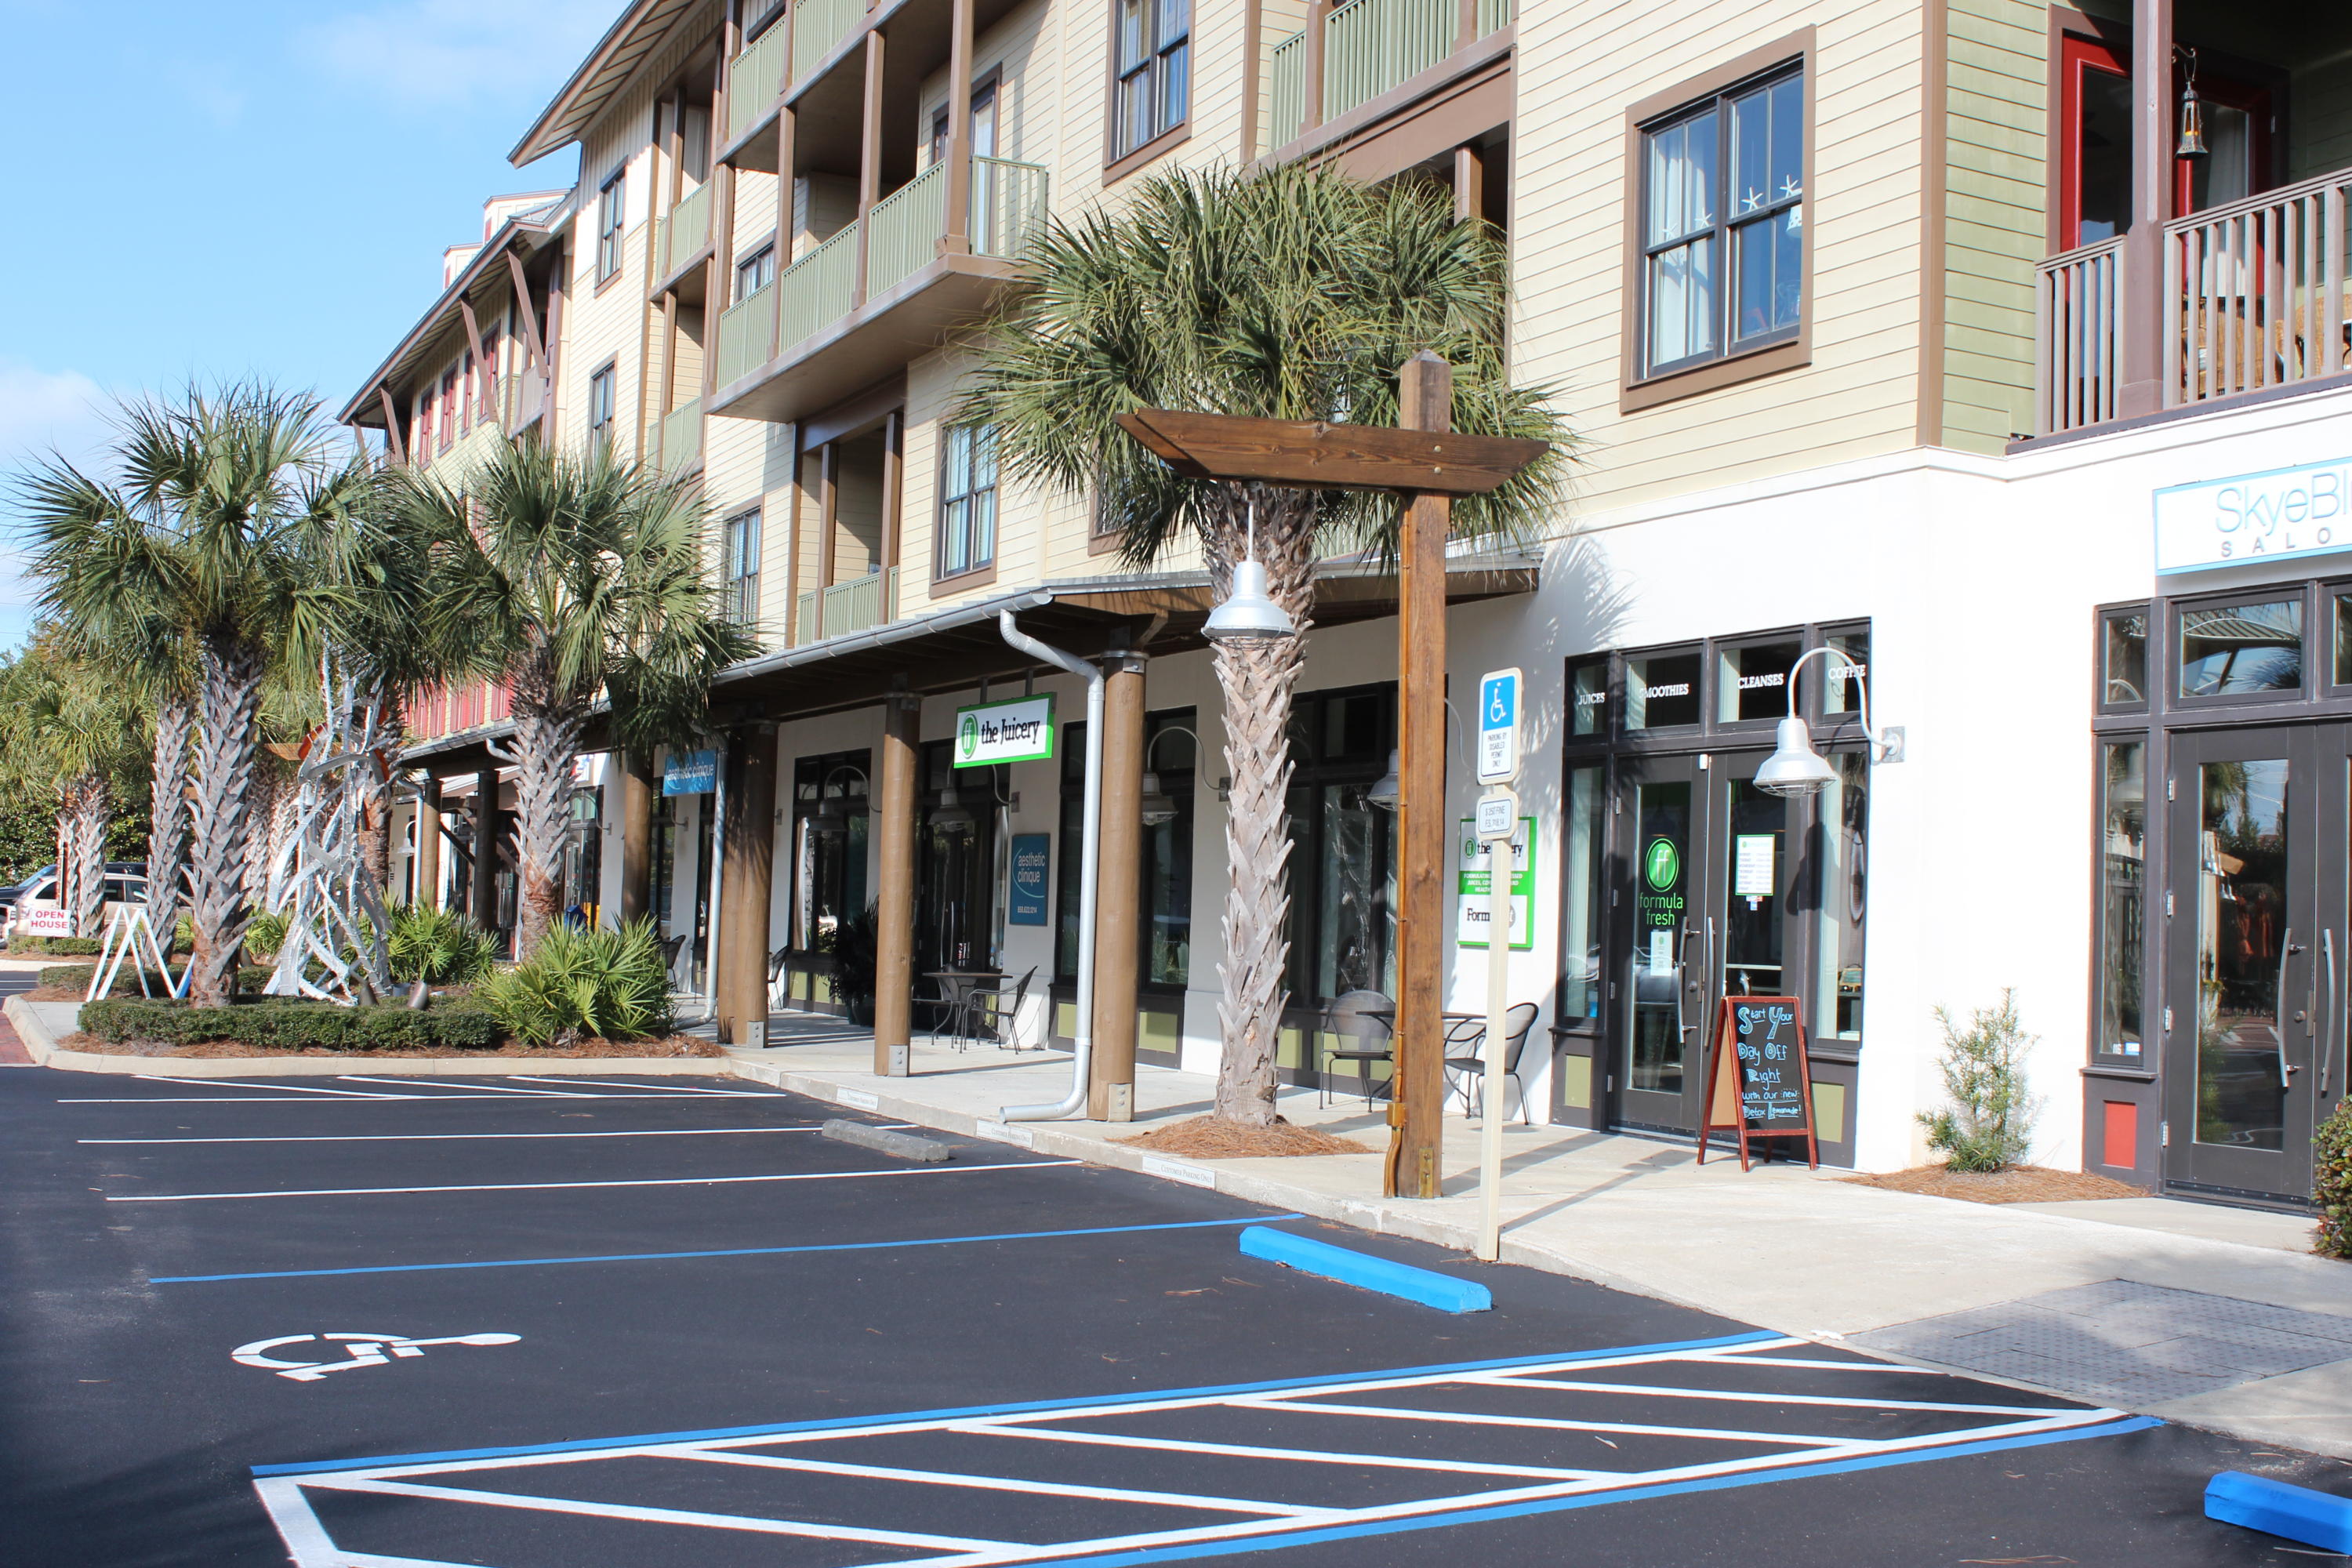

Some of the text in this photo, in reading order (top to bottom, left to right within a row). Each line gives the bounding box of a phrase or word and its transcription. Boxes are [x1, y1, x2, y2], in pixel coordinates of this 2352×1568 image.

[2216, 470, 2352, 536] SkyeBl
[1737, 673, 1784, 691] CLEANSES
[1577, 691, 1606, 706] JUICES
[1639, 683, 1690, 700] SMOOTHIES
[981, 717, 1040, 745] the Juicery
[1477, 841, 1491, 855] the
[1018, 852, 1046, 867] aesthetic
[1018, 868, 1040, 886] clinique
[1639, 892, 1683, 909] formula
[35, 910, 64, 919] OPEN
[1646, 909, 1675, 926] fresh
[31, 920, 68, 929] HOUSE
[1738, 1006, 1794, 1040] Start Your
[1737, 1042, 1788, 1066] Day Off
[1746, 1068, 1781, 1091] Right
[1742, 1091, 1761, 1100] with
[1763, 1091, 1778, 1100] our
